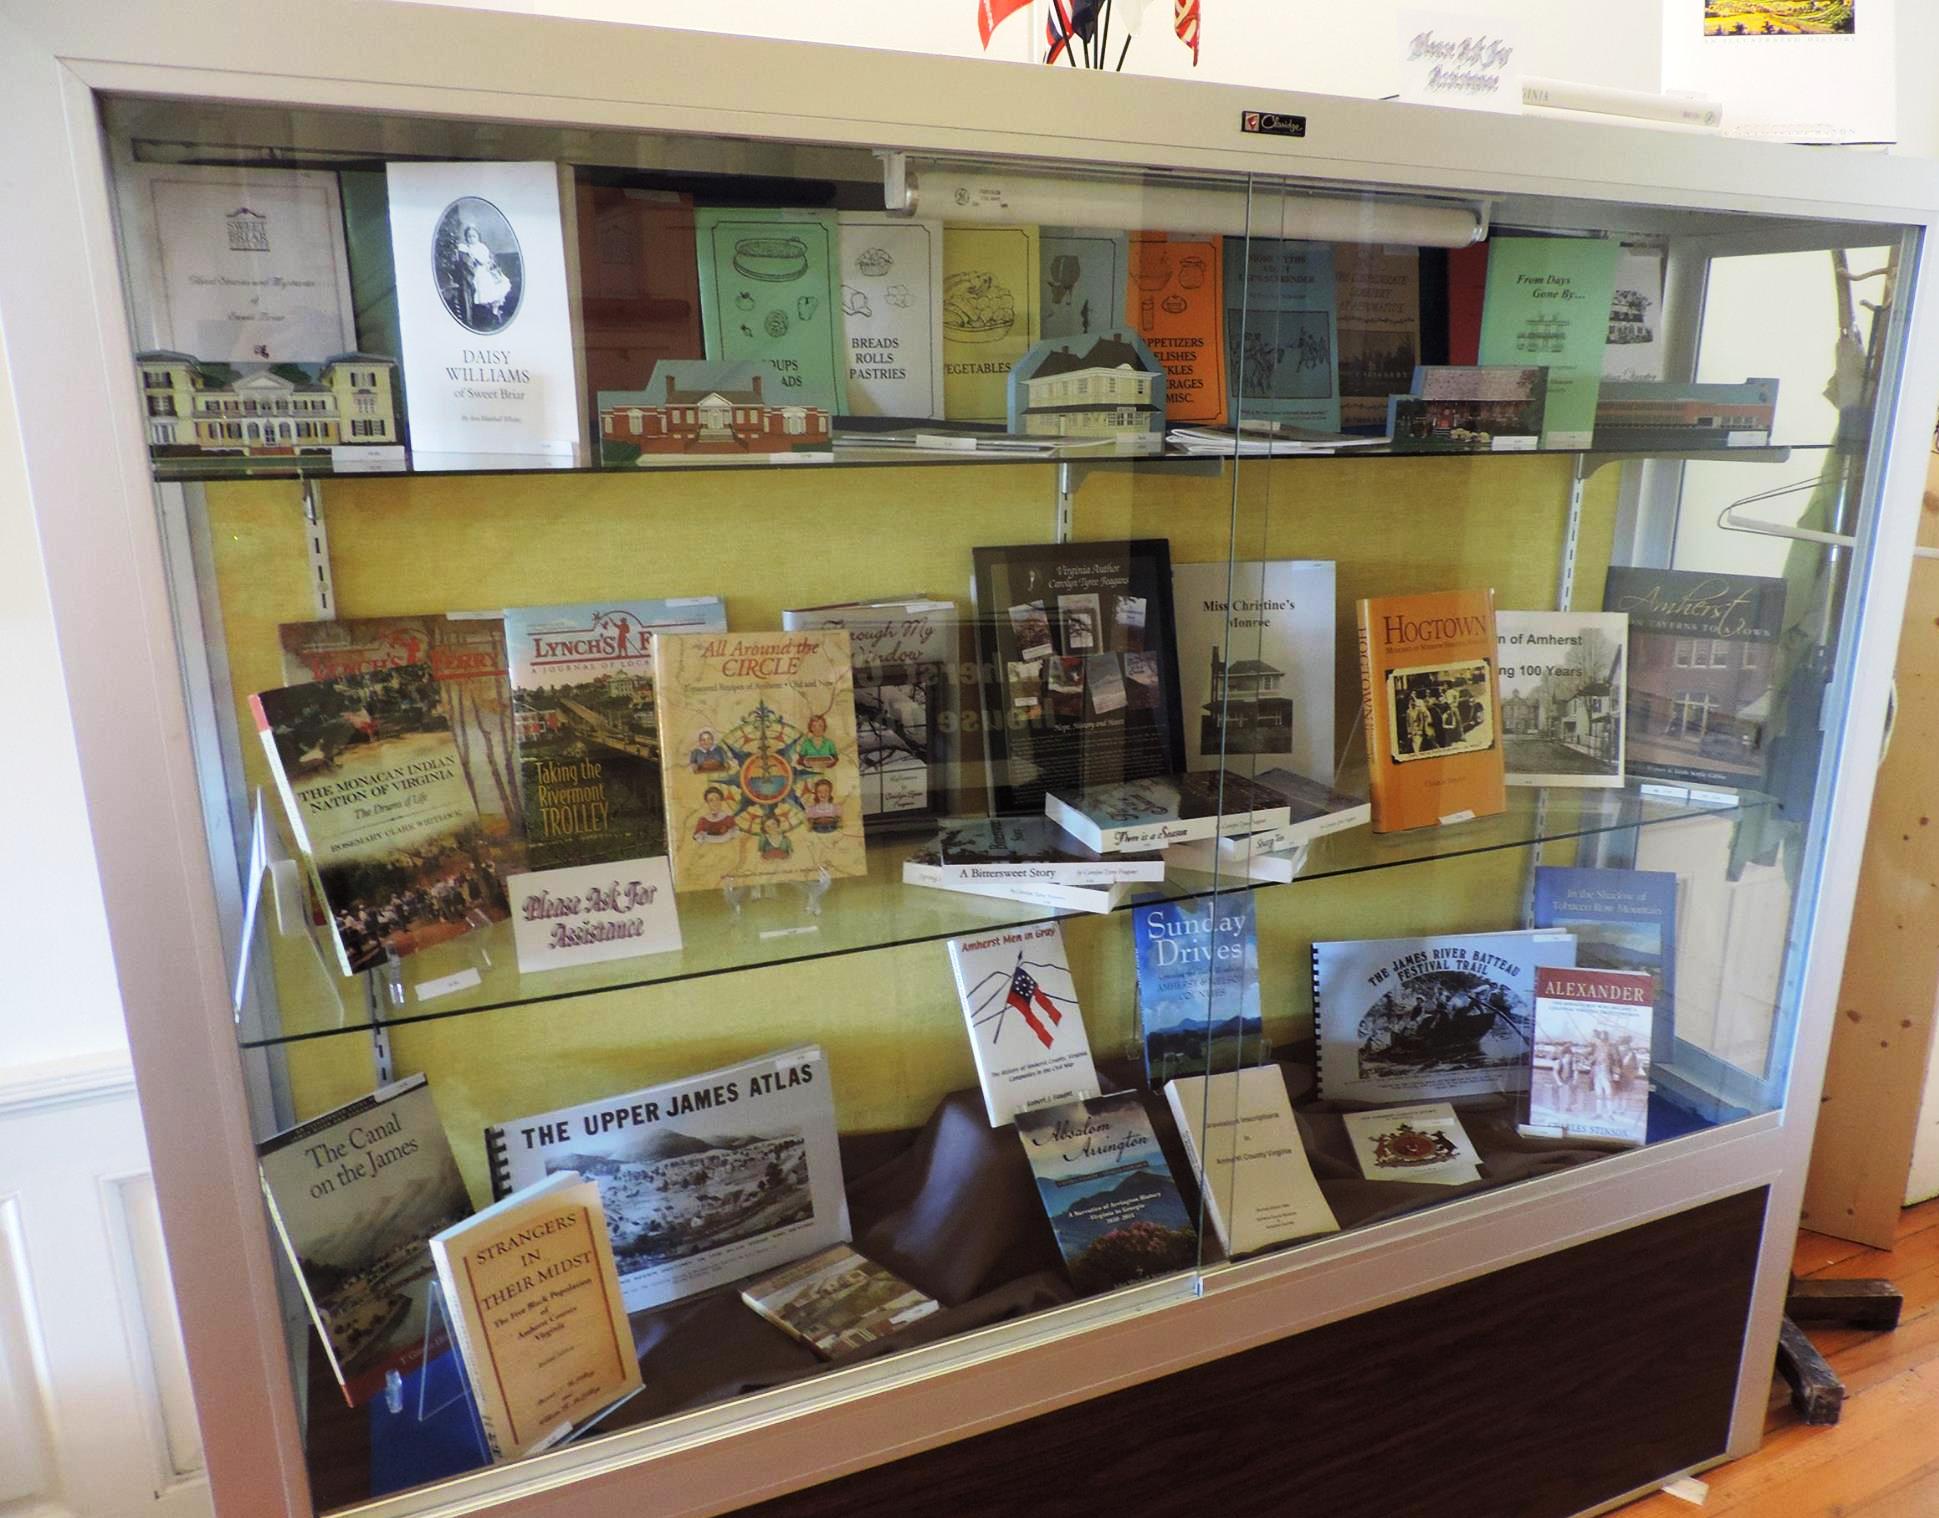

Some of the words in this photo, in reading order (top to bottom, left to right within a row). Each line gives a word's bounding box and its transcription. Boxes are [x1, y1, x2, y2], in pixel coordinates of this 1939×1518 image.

[1278, 254, 1307, 264] YTHS
[1516, 275, 1544, 285] From
[1546, 275, 1571, 285] Days
[1532, 288, 1559, 299] Gone
[852, 337, 900, 349] BREADS
[463, 349, 511, 365] DAISY
[768, 359, 798, 372] OUPS
[855, 353, 894, 364] ROLLS
[1153, 351, 1197, 361] ELISHES
[446, 367, 531, 384] WILLIAMS
[781, 375, 802, 388] ADS
[850, 367, 906, 380] PASTRIES
[1163, 365, 1193, 376] KLES
[454, 388, 466, 399] of
[467, 388, 498, 400] Sweet
[500, 388, 526, 401] Briar
[1166, 378, 1204, 389] RAGES
[1203, 600, 1229, 612] Miss
[1232, 599, 1295, 612] Christine's
[1617, 577, 1753, 637] Amherst
[838, 620, 897, 647] rough
[901, 616, 936, 644] My
[1383, 614, 1487, 645] HOGTOWN
[1510, 633, 1524, 645] of
[1526, 633, 1583, 646] Amherst
[532, 633, 616, 658] LYNCH'S
[701, 639, 728, 658] All
[729, 638, 792, 657] Around
[794, 636, 820, 656] the
[543, 663, 595, 674] JOURNAL
[620, 659, 650, 668] LOCA
[721, 656, 801, 680] CIRCLE
[1358, 626, 1374, 720] HOGTOWN
[1519, 665, 1542, 676] 100
[1546, 665, 1583, 677] Years
[297, 783, 334, 802] THE
[336, 767, 406, 793] MONACAN
[407, 755, 456, 775] INDIAN
[535, 761, 579, 785] Taking
[580, 757, 602, 780] the
[310, 788, 368, 814] NATION
[371, 784, 390, 798] OF
[391, 770, 455, 791] VIRGINIA
[538, 783, 606, 808] Rivermont
[539, 802, 609, 836] TROLLEY
[330, 831, 384, 853] ROSEMARY
[384, 822, 416, 838] CLARK
[416, 810, 463, 831] WHITLOCK
[1114, 831, 1140, 846] There
[1141, 832, 1148, 841] is
[1157, 825, 1188, 840] Season
[959, 868, 968, 878] A
[971, 867, 1028, 879] Bittersweet
[1029, 867, 1057, 881] Story
[522, 889, 580, 922] Please
[584, 880, 626, 914] Ask
[625, 880, 658, 911] For
[1146, 900, 1247, 939] Sunday
[547, 917, 647, 949] Assistance
[961, 936, 1001, 953] Amherst
[1003, 932, 1023, 946] Men
[1024, 930, 1034, 941] in
[1035, 927, 1057, 940] Gray
[1153, 937, 1243, 968] Drives
[1367, 967, 1390, 987] THE
[1392, 951, 1428, 972] JAMES
[1433, 948, 1467, 960] RIVER
[1472, 950, 1521, 977] BATTEAU
[1397, 959, 1450, 982] FESTIVAL
[1456, 959, 1489, 976] TRAIL
[1544, 980, 1645, 1003] ALEXANDER
[521, 1121, 571, 1149] THE
[583, 1102, 660, 1136] UPPER
[666, 1082, 740, 1118] JAMES
[749, 1064, 814, 1098] ATLAS
[305, 1142, 348, 1169] The
[348, 1112, 403, 1149] Canal
[1062, 1130, 1150, 1163] Arrington
[310, 1178, 335, 1199] on
[336, 1163, 367, 1187] the
[367, 1138, 419, 1178] James
[476, 1213, 577, 1265] STRANGERS
[520, 1249, 541, 1267] IN
[480, 1275, 535, 1311] THEIR
[537, 1250, 592, 1283] MIDST
